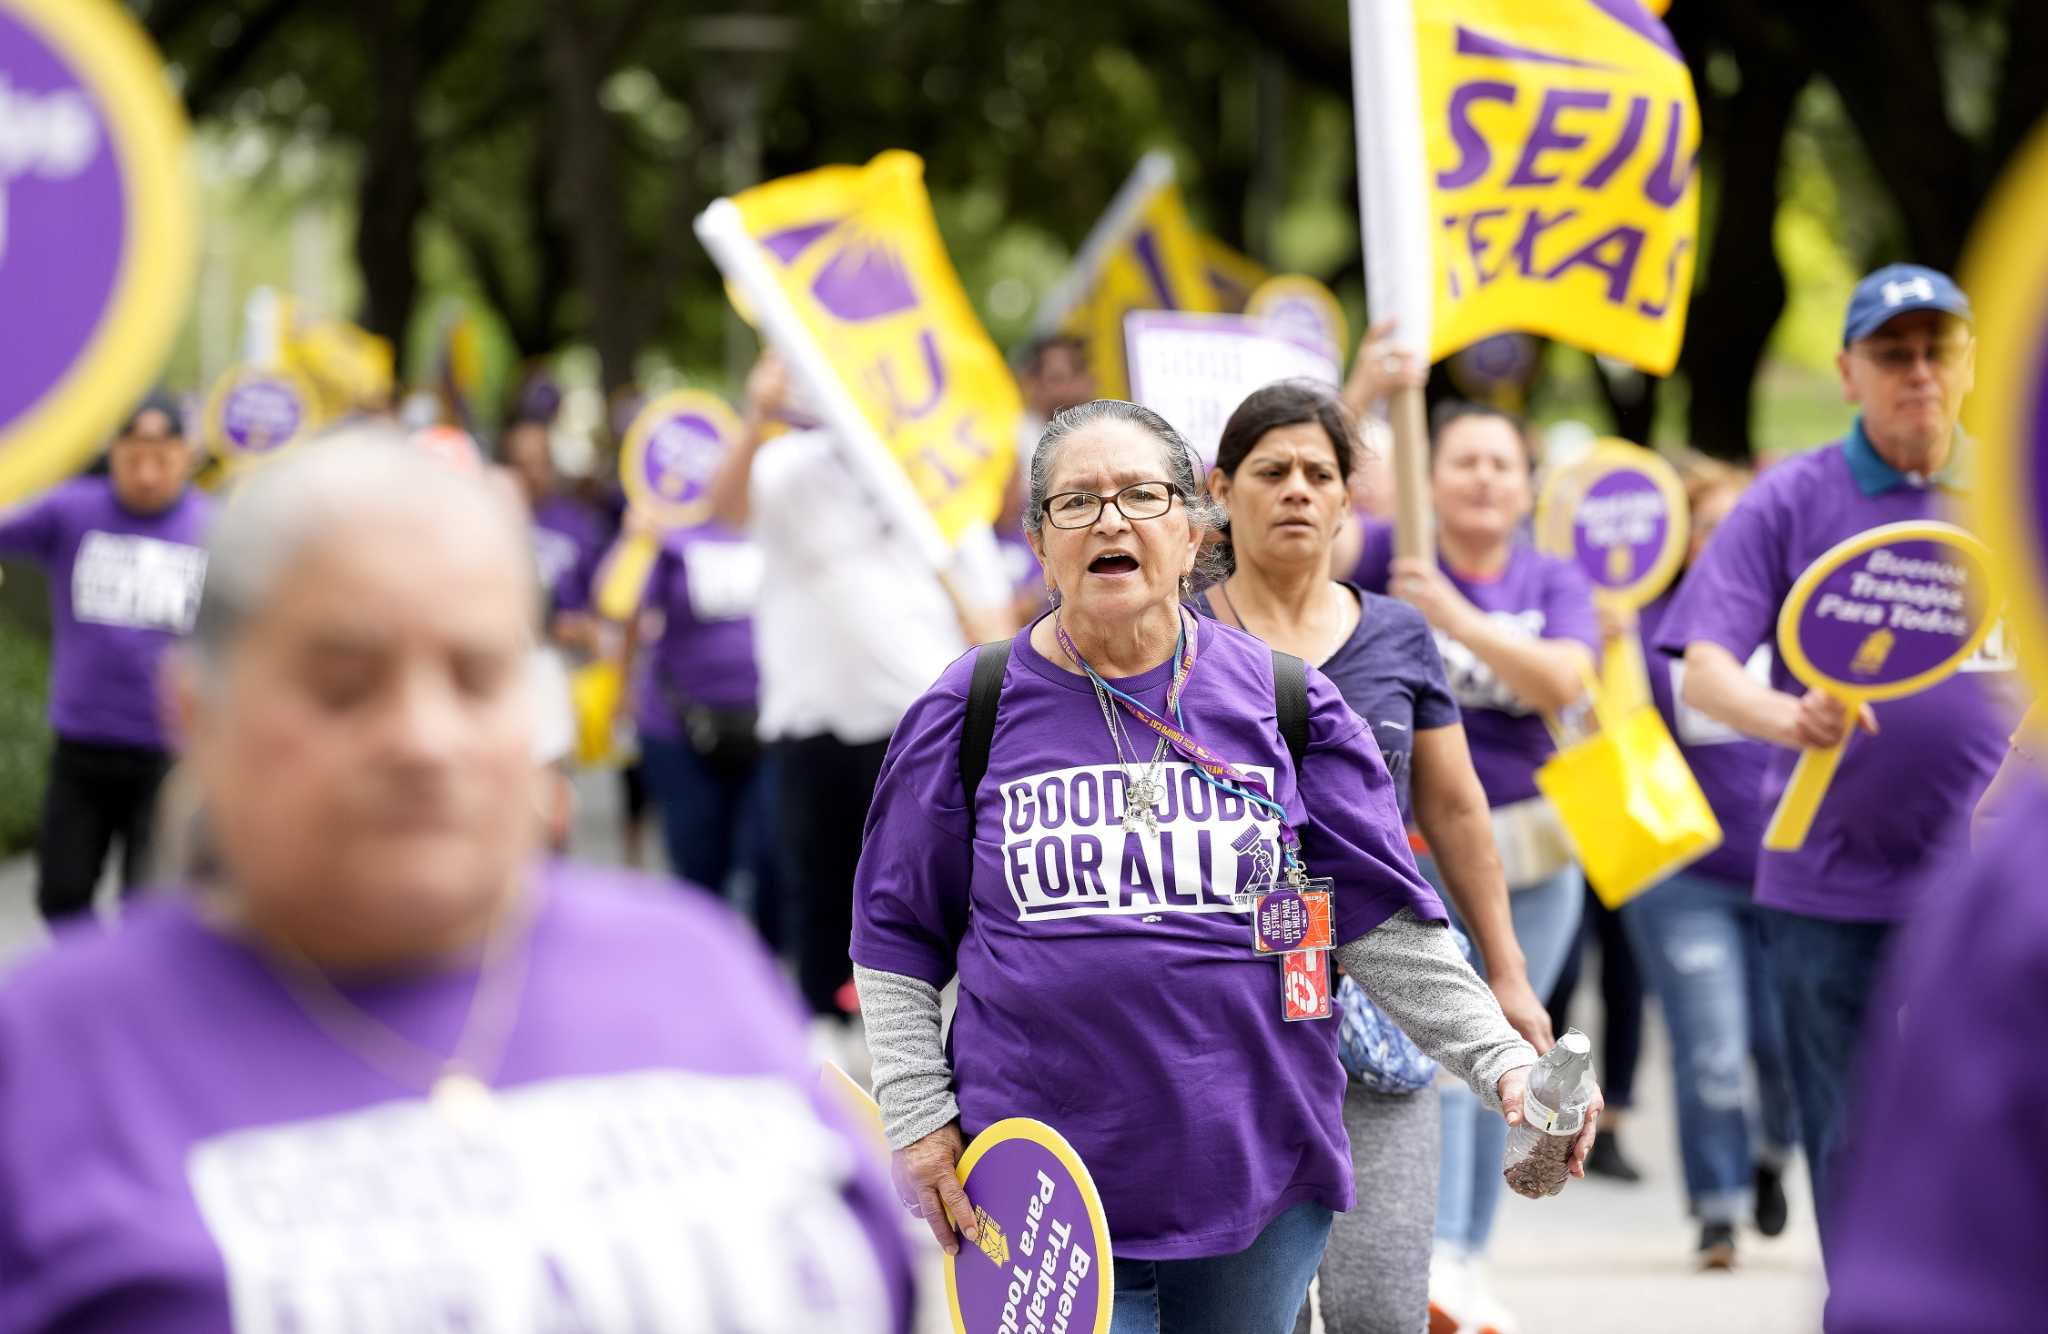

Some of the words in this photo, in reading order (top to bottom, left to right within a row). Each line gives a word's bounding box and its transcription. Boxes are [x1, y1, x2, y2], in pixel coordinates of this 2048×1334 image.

[1435, 80, 1698, 209] SEIU
[1866, 549, 1967, 586] Buenos
[1850, 571, 1964, 611] Trabajos
[1815, 593, 1884, 625] Para
[1889, 603, 1968, 636] Todos
[1008, 770, 1130, 835] GOOD
[1007, 834, 1107, 902] FOR
[1119, 830, 1234, 907] ALL
[1262, 911, 1271, 935] READY
[1270, 903, 1280, 928] STRIKE
[1282, 898, 1292, 919] PARA
[1292, 900, 1301, 928] HUELGA
[1271, 929, 1281, 940] TO
[1293, 929, 1302, 940] LA
[1019, 1169, 1055, 1257] Para
